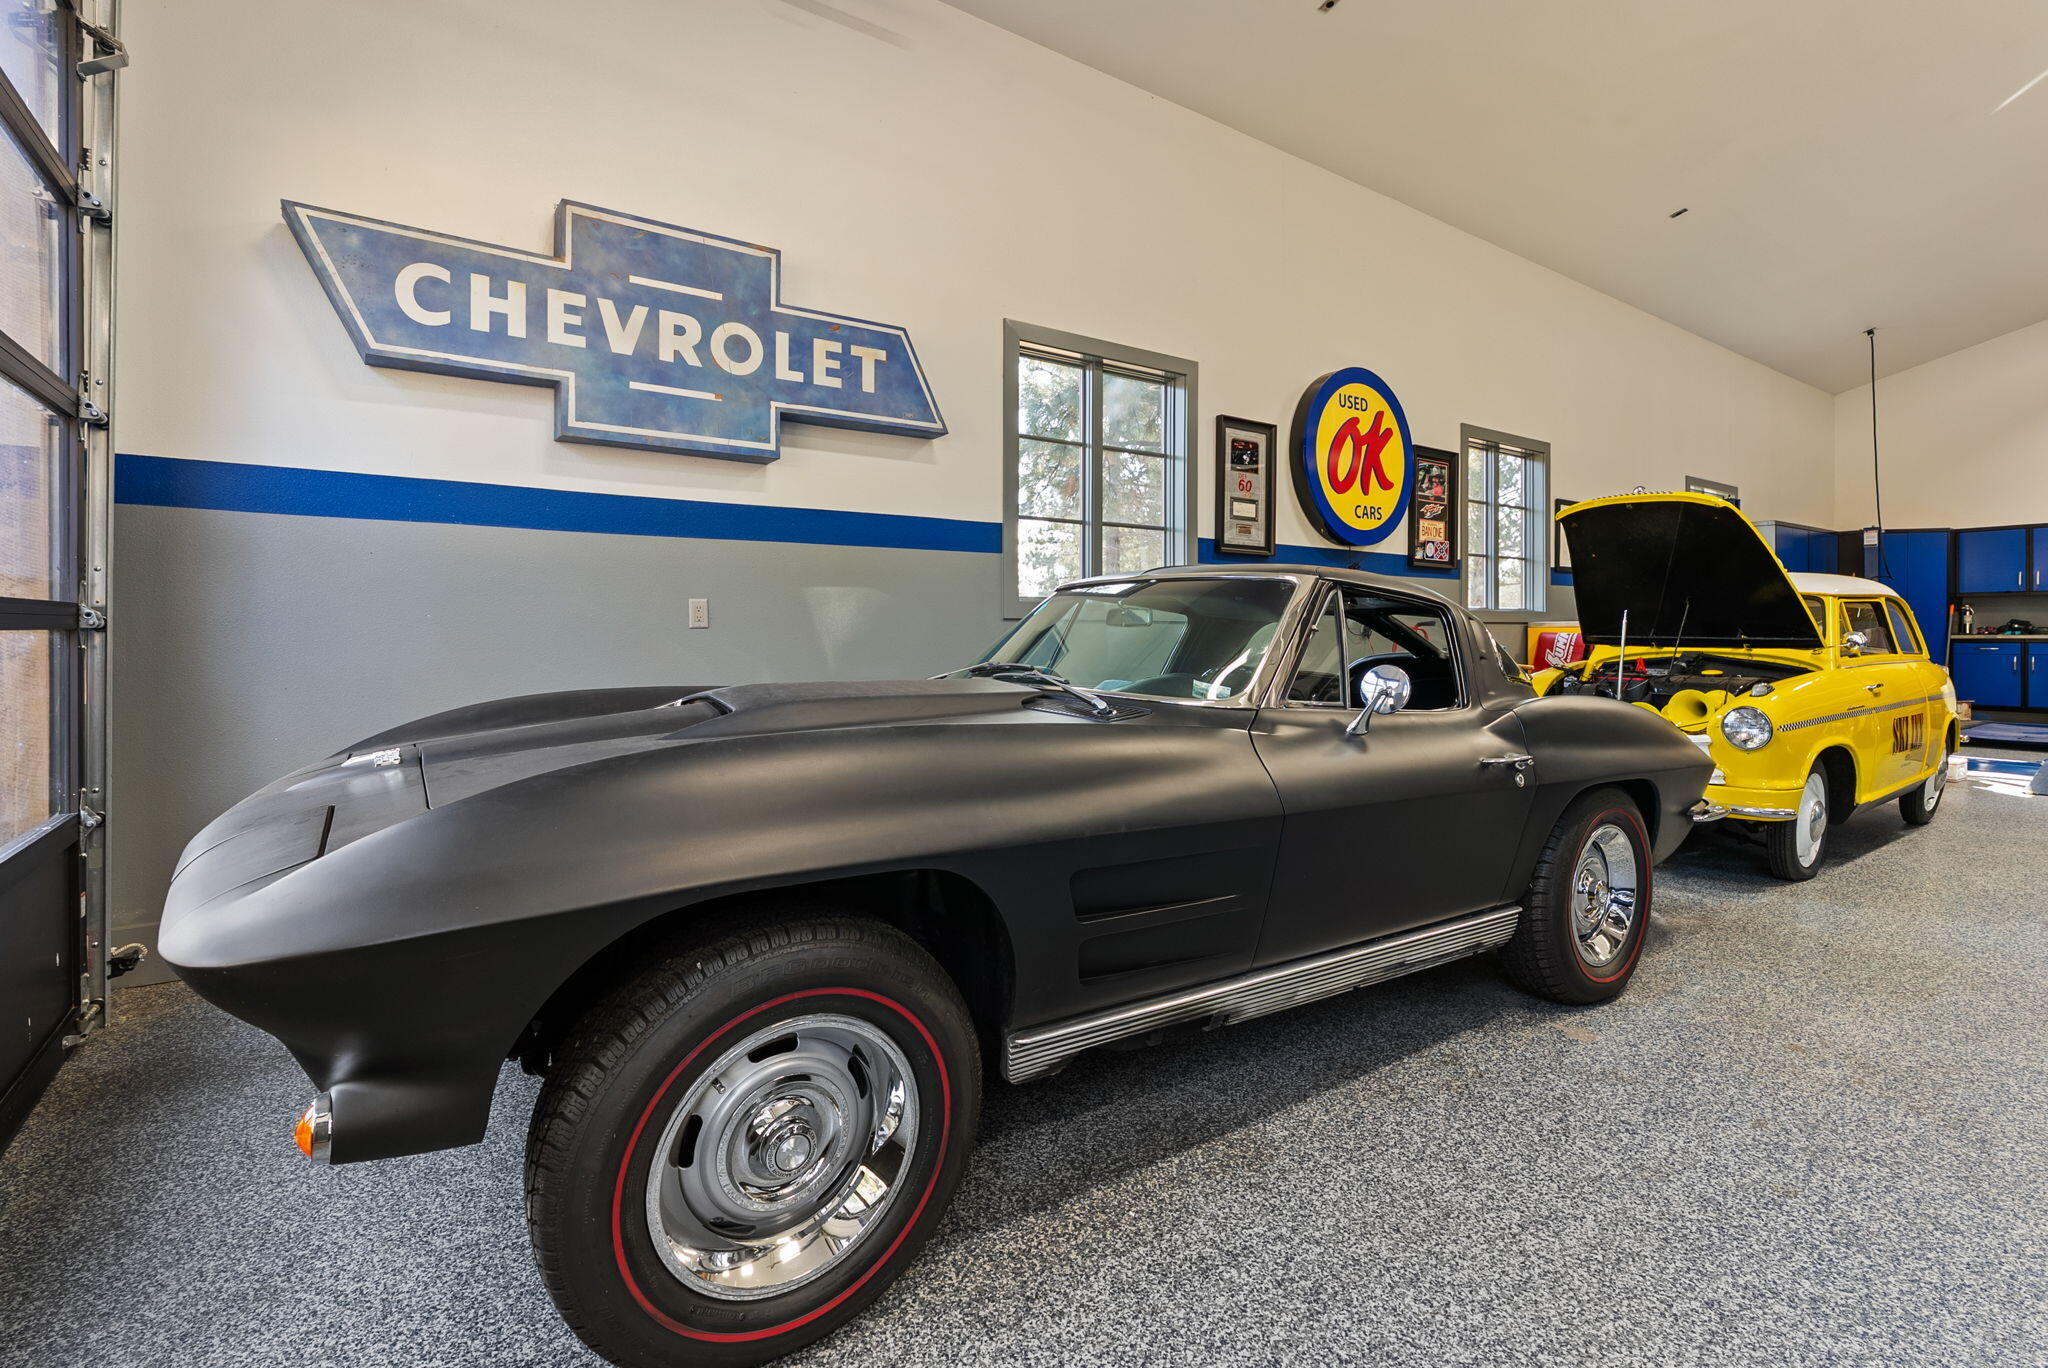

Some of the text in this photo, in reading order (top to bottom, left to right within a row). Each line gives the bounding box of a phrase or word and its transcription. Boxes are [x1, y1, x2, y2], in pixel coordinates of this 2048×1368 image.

[394, 262, 887, 393] CHEVROLET
[1338, 393, 1368, 412] USED
[1327, 410, 1395, 496] OK
[1238, 479, 1252, 492] 60
[1354, 504, 1383, 521] CARS
